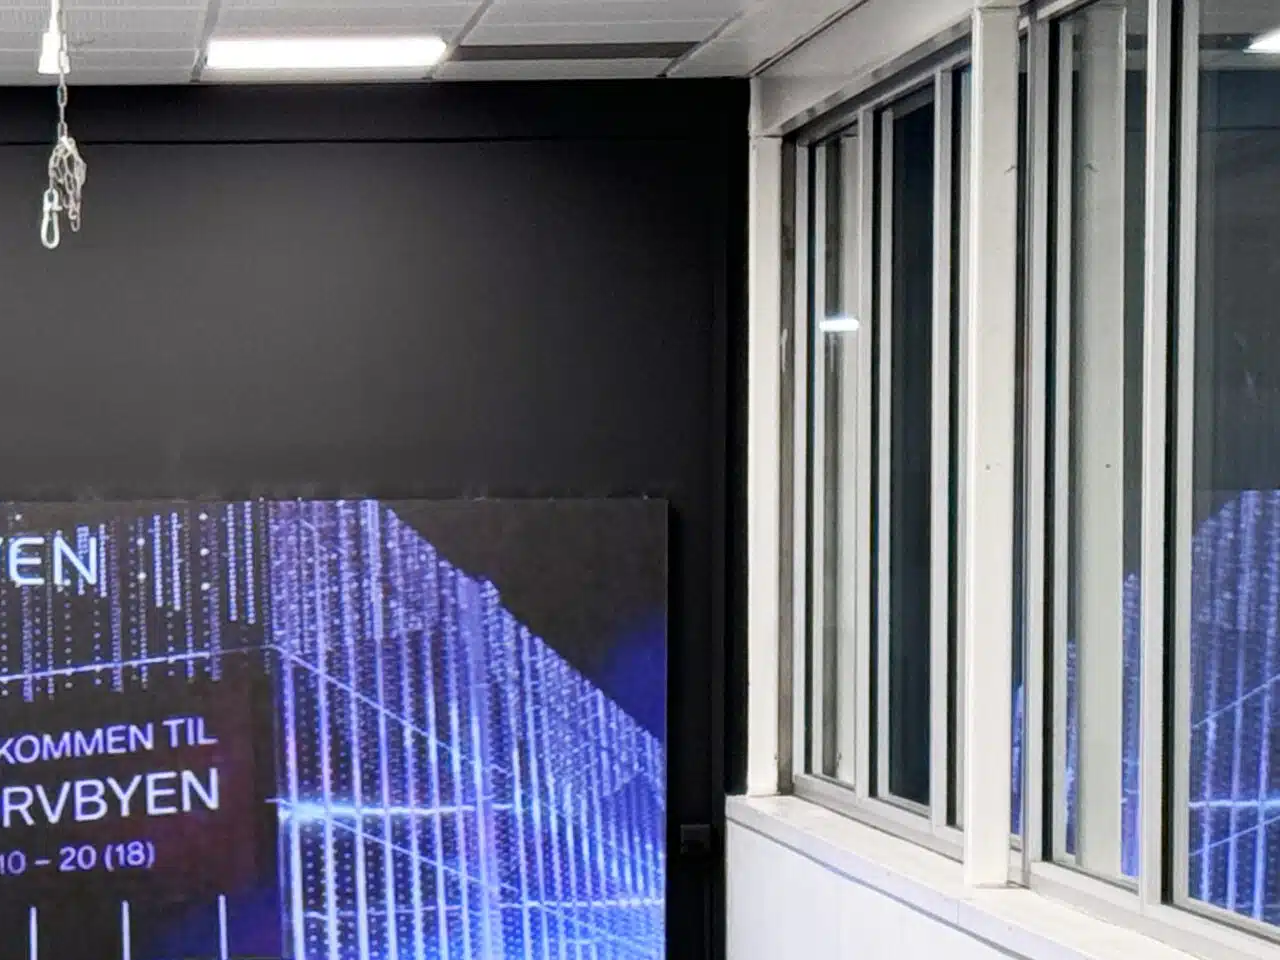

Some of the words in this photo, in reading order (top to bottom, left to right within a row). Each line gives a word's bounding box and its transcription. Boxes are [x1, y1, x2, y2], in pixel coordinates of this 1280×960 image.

[162, 716, 219, 748] TIL
[58, 845, 97, 872] 20
[104, 840, 155, 872] (18)
